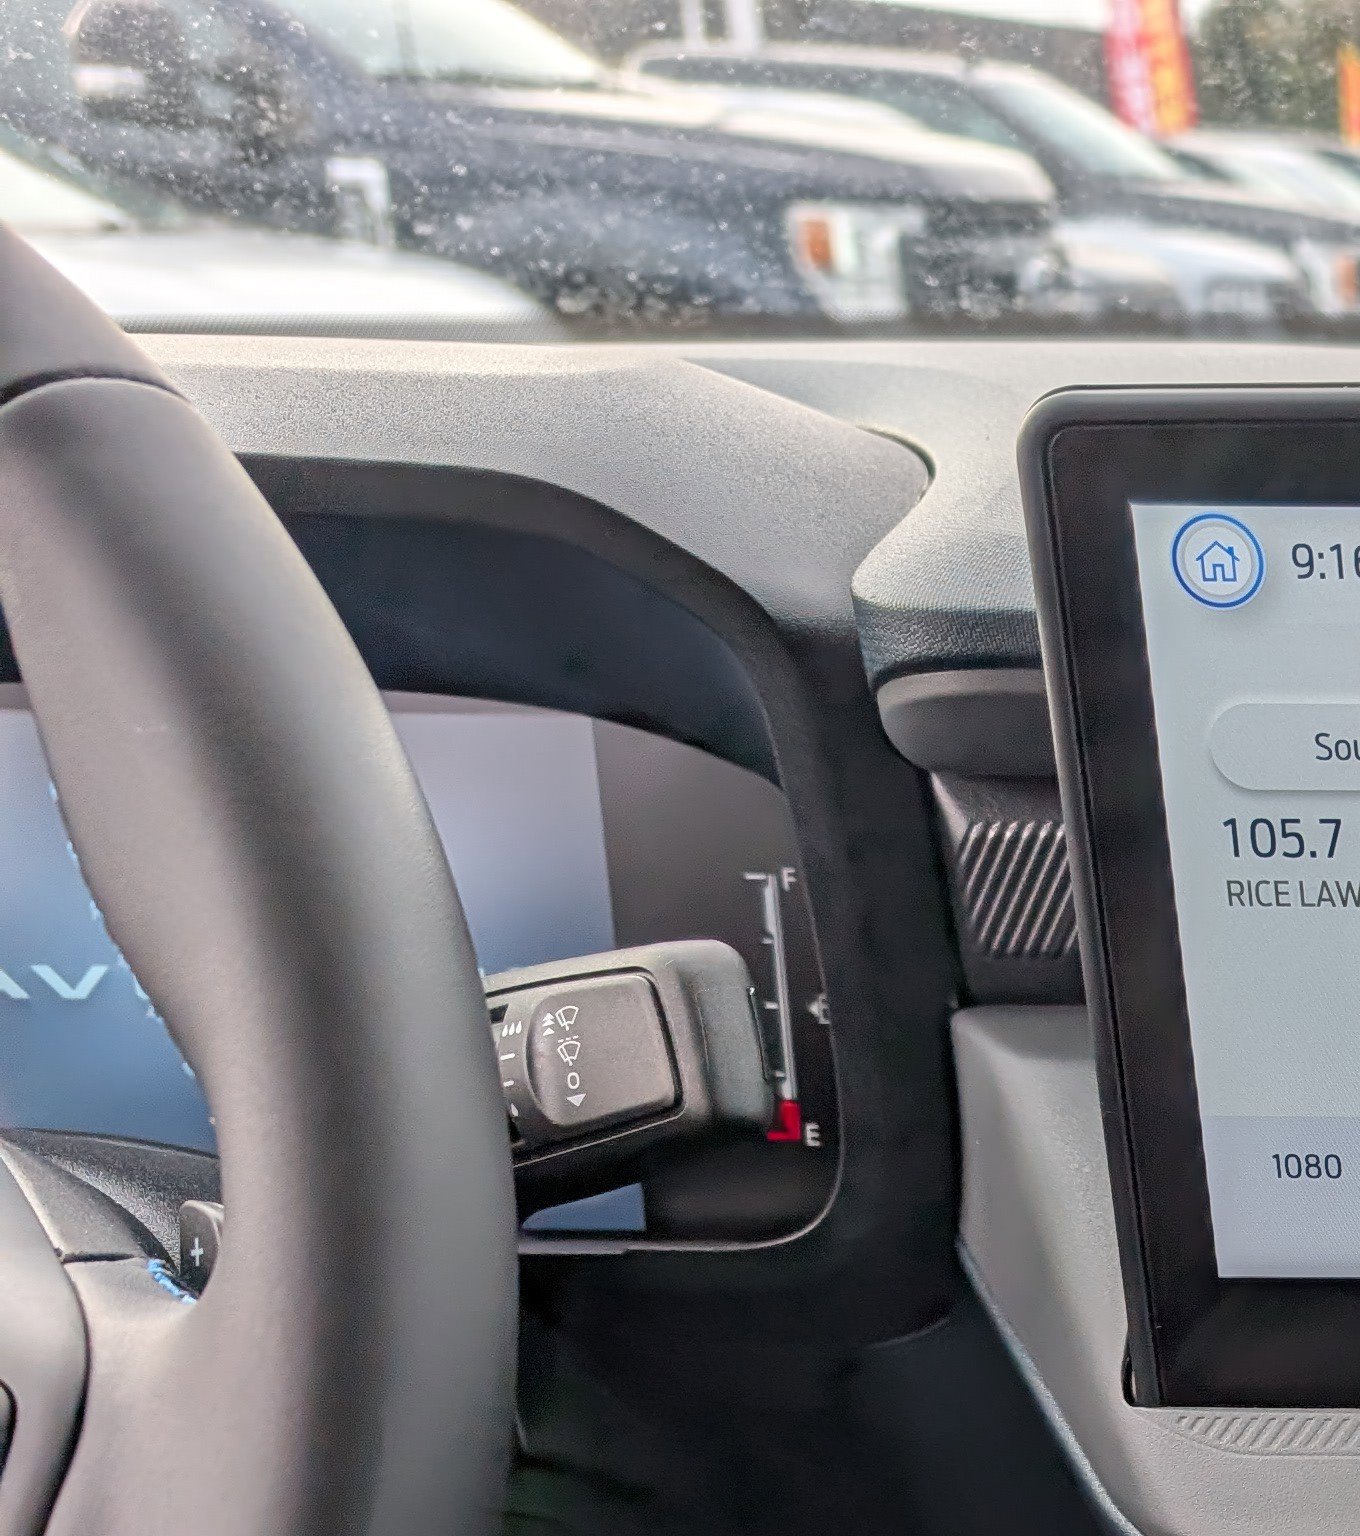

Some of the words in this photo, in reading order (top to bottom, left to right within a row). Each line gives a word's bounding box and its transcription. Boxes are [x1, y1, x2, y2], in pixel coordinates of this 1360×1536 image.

[1222, 817, 1342, 859] 105.7
[780, 866, 797, 891] F
[1226, 879, 1292, 908] RICE
[804, 1121, 821, 1147] E
[1271, 1153, 1343, 1180] 1080
